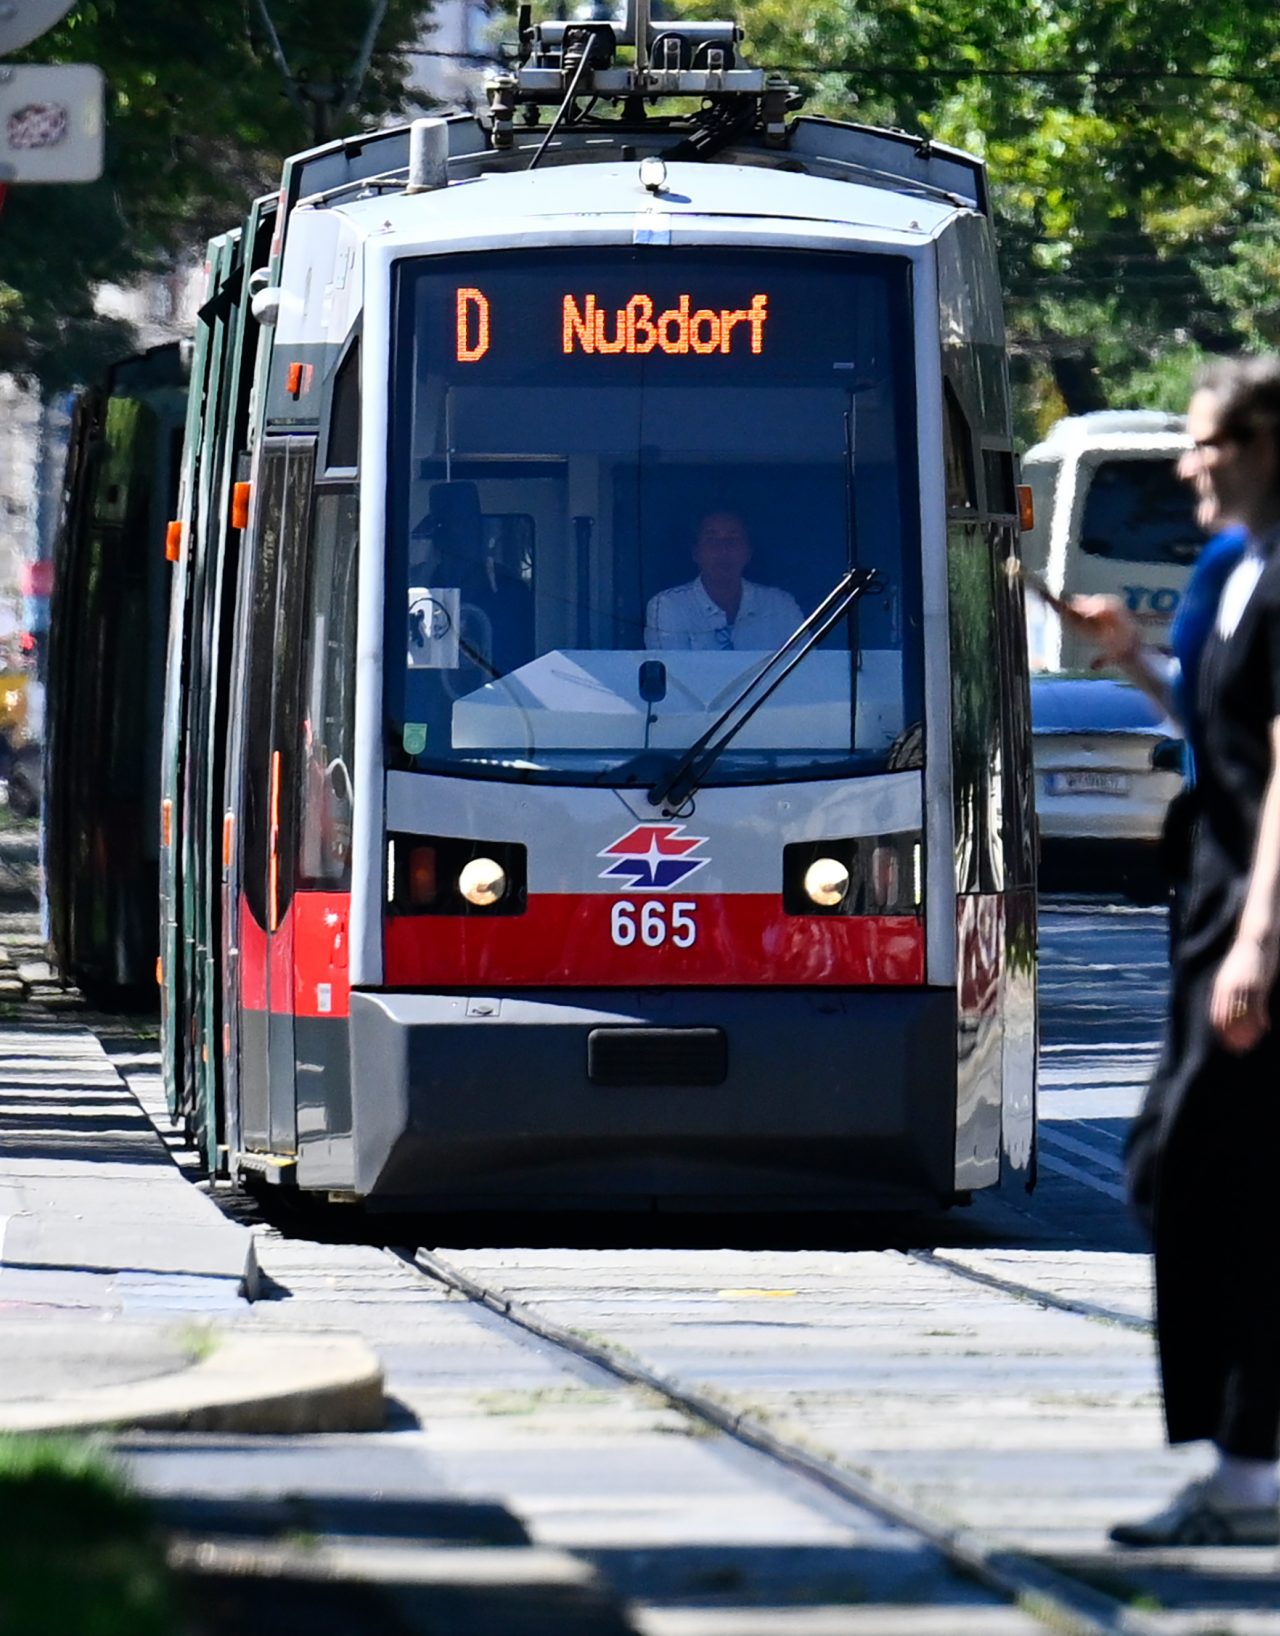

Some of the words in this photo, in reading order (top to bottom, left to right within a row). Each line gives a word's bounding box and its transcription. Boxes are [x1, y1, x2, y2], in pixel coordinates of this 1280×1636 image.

[456, 287, 490, 362] D
[562, 293, 768, 354] Nußdorf
[611, 900, 697, 948] 665
